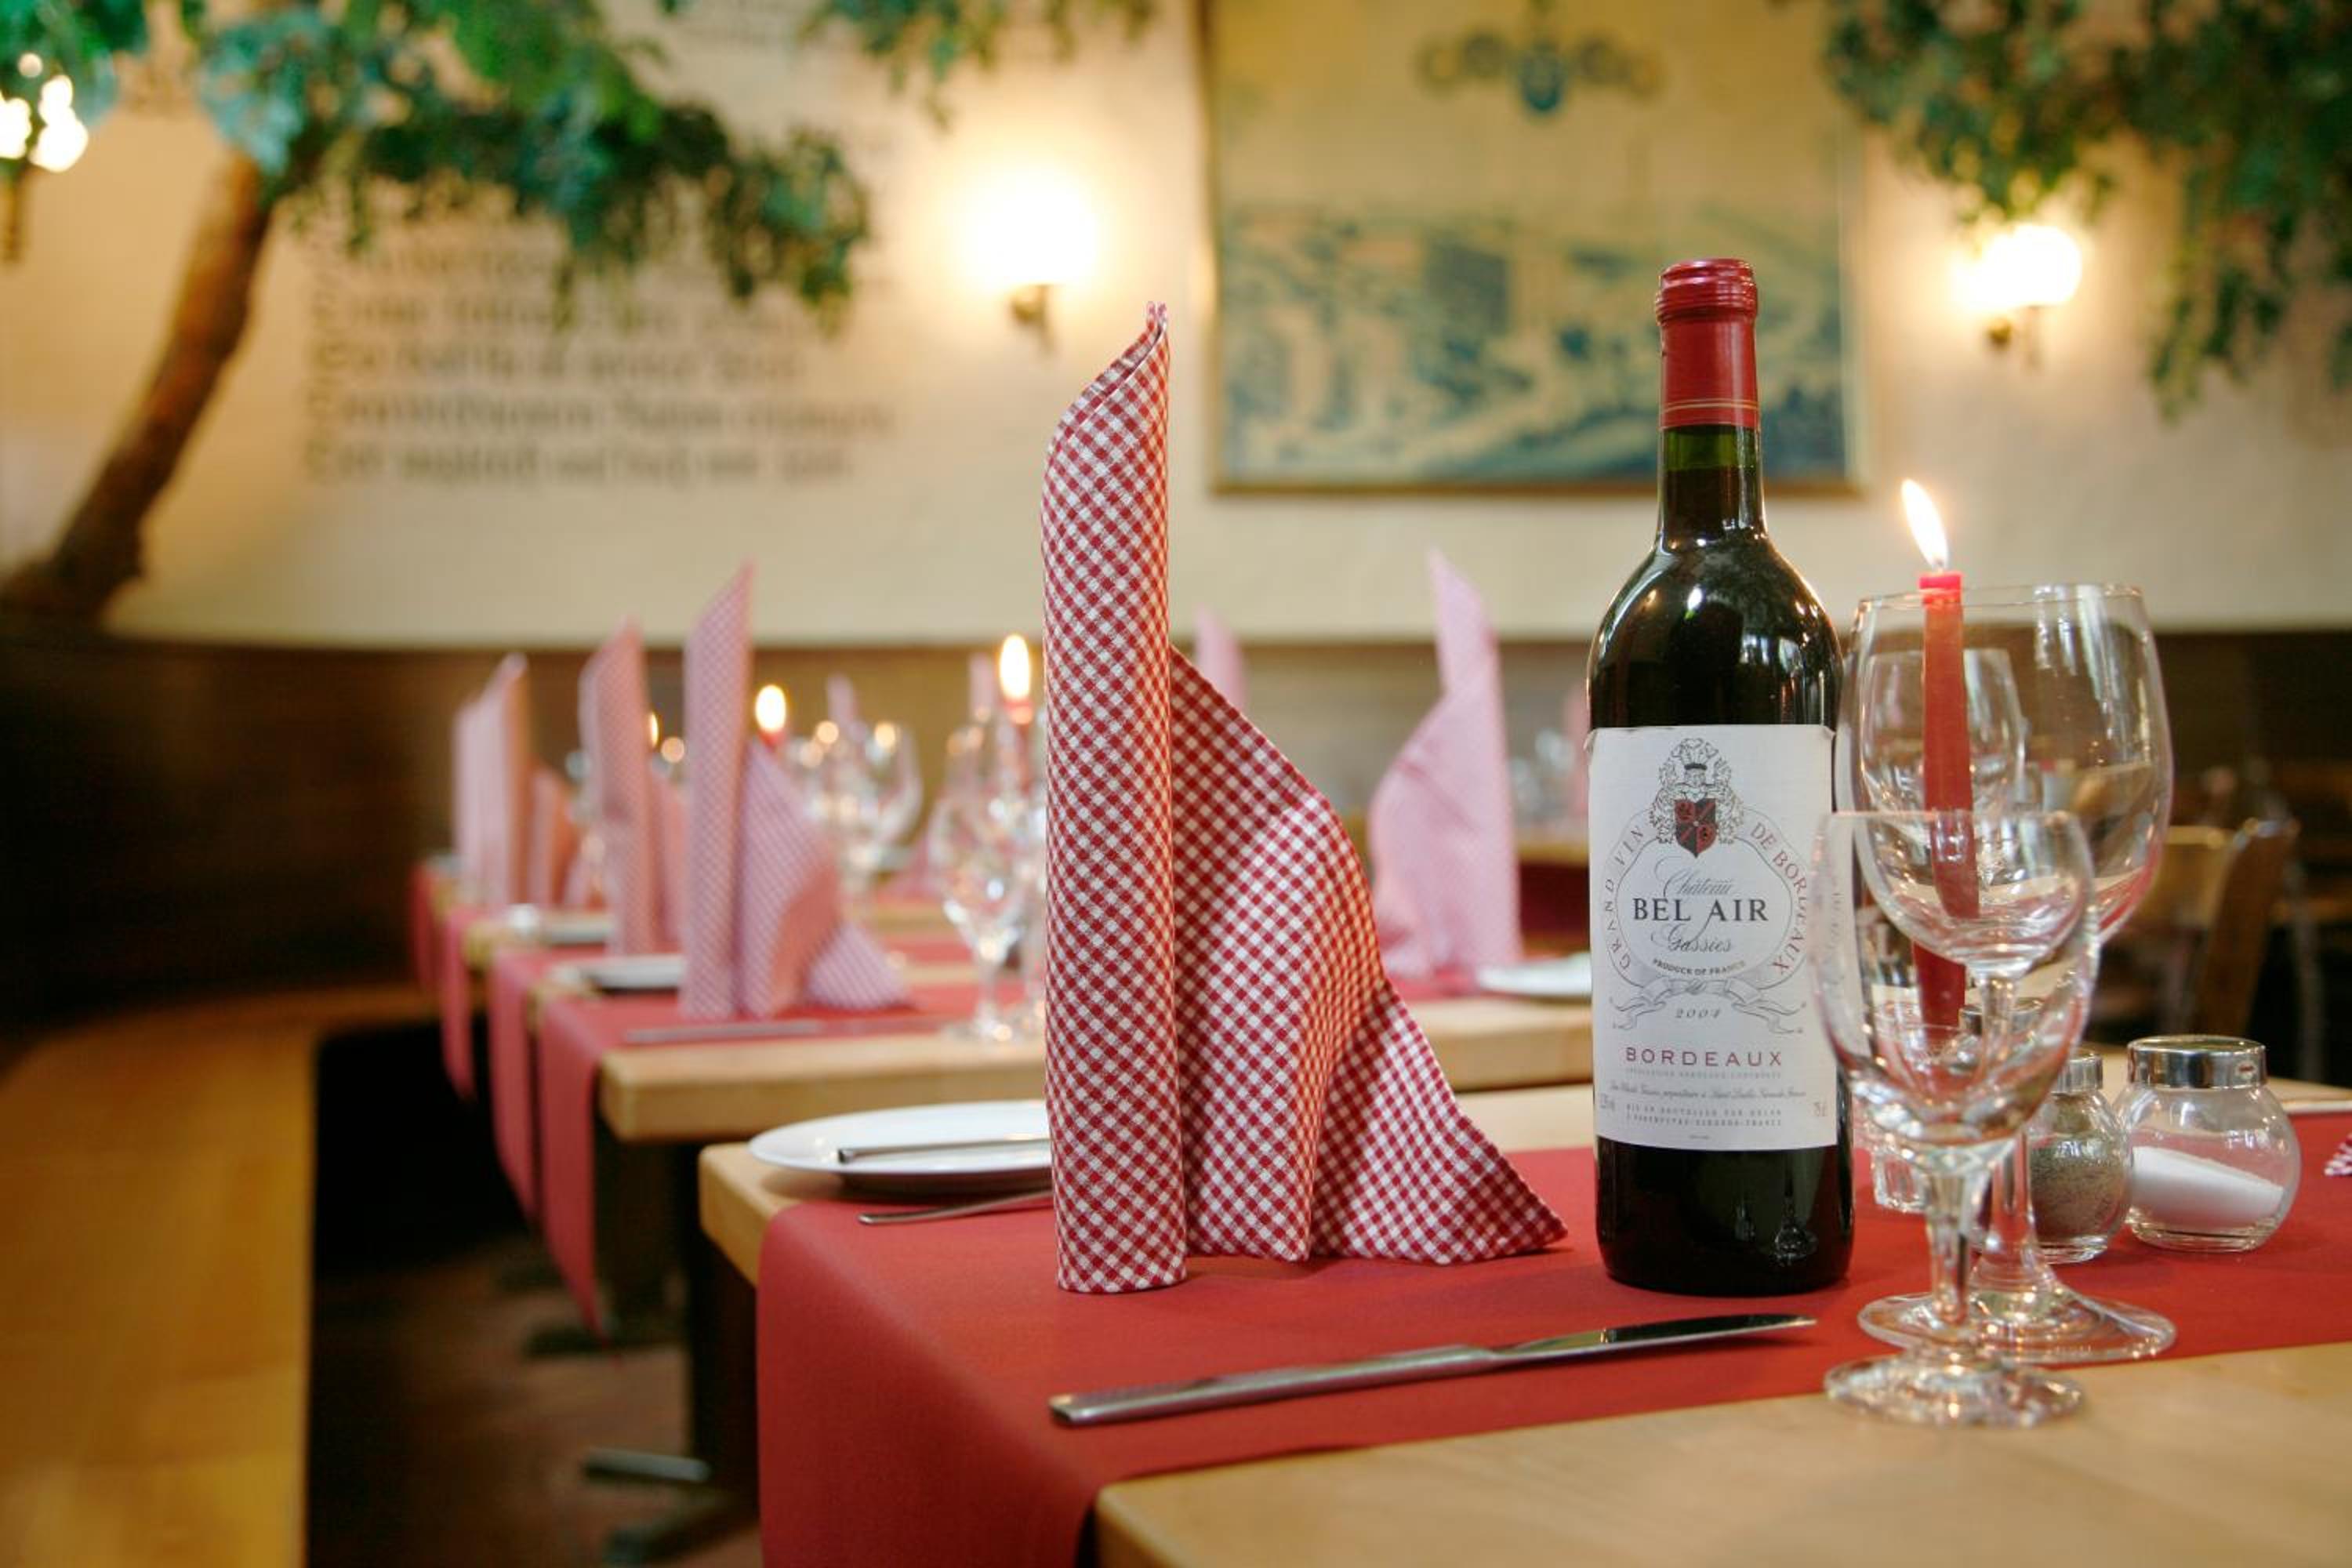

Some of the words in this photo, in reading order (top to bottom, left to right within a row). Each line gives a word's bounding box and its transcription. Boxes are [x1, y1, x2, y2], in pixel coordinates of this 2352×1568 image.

[1614, 826, 1643, 866] VIN
[1750, 822, 1778, 851] DE
[1633, 898, 1691, 921] BEL
[1709, 899, 1769, 922] AIR
[1626, 1047, 1782, 1067] BORDEAUX
